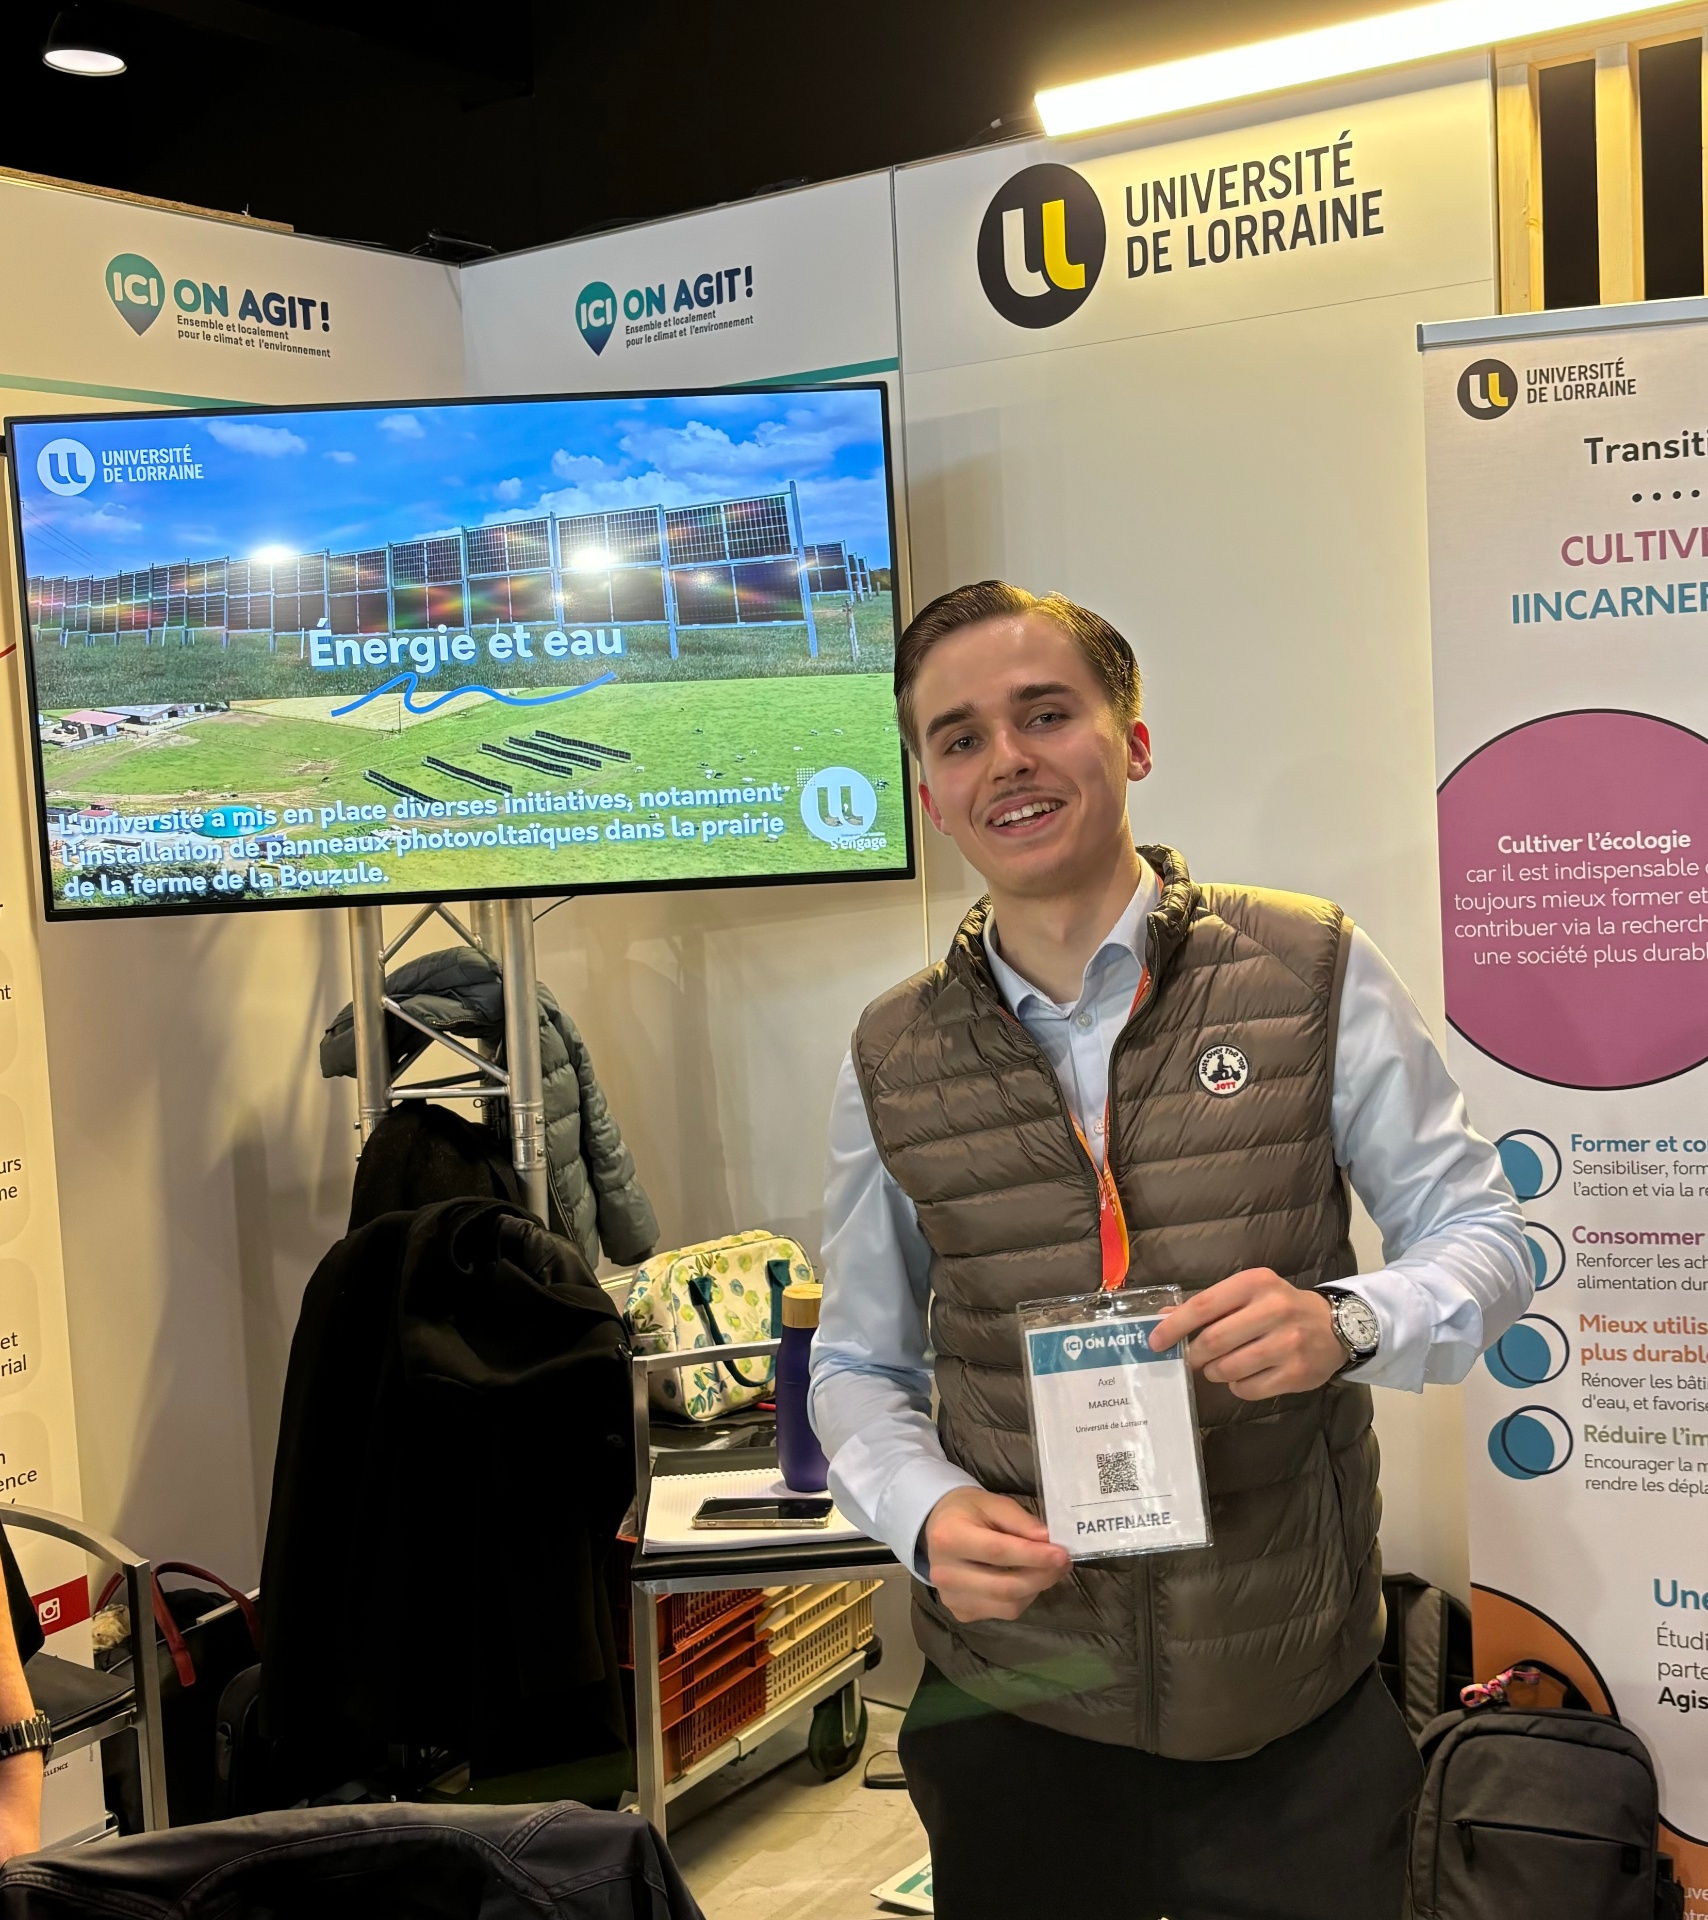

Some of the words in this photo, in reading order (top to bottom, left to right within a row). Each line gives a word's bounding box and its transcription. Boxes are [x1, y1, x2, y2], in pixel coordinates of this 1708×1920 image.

[1125, 129, 1355, 227] UNIVERSITÉ
[1127, 229, 1173, 279] DE
[1187, 189, 1384, 267] LORRAINE
[113, 272, 159, 307] ICI
[173, 278, 229, 317] ON
[580, 298, 613, 330] ICI
[623, 283, 666, 321] ON
[177, 314, 224, 331] Ensemble
[225, 321, 236, 333] et
[238, 323, 289, 340] localement
[625, 319, 662, 335] Ensemble
[663, 318, 672, 328] et
[673, 309, 716, 326] localement
[626, 338, 643, 349] pour
[644, 334, 652, 344] le
[653, 328, 677, 342] climat
[678, 328, 687, 338] et
[690, 315, 754, 335] l'environnement
[178, 328, 200, 341] pour
[202, 330, 211, 342] le
[213, 333, 243, 347] climat
[245, 337, 255, 348] et
[259, 338, 331, 358] l'environnement
[1526, 357, 1625, 386] UNIVERSITÉ
[1527, 387, 1548, 404] DE
[1554, 378, 1637, 402] LORRAINE
[101, 444, 193, 466] UNIVERSITÉ
[103, 467, 124, 483] DE
[128, 463, 204, 482] LORRAINE
[308, 618, 477, 674] Énergie
[488, 624, 534, 660] et
[543, 627, 624, 658] eau
[58, 806, 205, 836] L'université
[211, 811, 226, 828] a
[232, 803, 277, 828] mis
[283, 805, 310, 825] en
[320, 800, 387, 829] place
[393, 795, 498, 819] diverses
[504, 789, 635, 815] initiatives,
[639, 782, 783, 809] notamment
[61, 838, 223, 868] l'installation
[229, 835, 260, 860] de
[267, 836, 390, 867] panneaux
[396, 820, 600, 857] photovoltaïques
[605, 816, 666, 841] dans
[671, 815, 696, 838] la
[701, 812, 785, 843] prairie
[1498, 834, 1583, 854] Cultiver
[1587, 830, 1691, 854] l’écologie
[63, 874, 95, 899] de
[102, 871, 126, 896] la
[133, 869, 207, 894] ferme
[212, 867, 243, 891] de
[249, 866, 274, 888] la
[280, 860, 390, 888] Bouzule.
[1466, 868, 1496, 883] car
[1502, 863, 1514, 882] il
[1519, 863, 1549, 881] est
[1554, 857, 1699, 884] indispensable
[1454, 892, 1537, 915] toujours
[1542, 890, 1606, 908] mieux
[1611, 887, 1684, 906] former
[1454, 918, 1557, 938] contribuer
[1562, 918, 1591, 936] via
[1597, 916, 1616, 935] la
[1474, 951, 1511, 965] une
[1517, 944, 1588, 965] société
[1594, 943, 1638, 968] plus
[1214, 1081, 1236, 1091] JOTT
[1571, 1133, 1651, 1153] Former
[1656, 1136, 1679, 1153] et
[1572, 1160, 1669, 1178] Sensibiliser,
[1573, 1181, 1628, 1197] l’action
[1632, 1183, 1649, 1197] et
[1651, 1183, 1675, 1197] via
[1679, 1181, 1694, 1197] la
[1572, 1225, 1706, 1246] Consommer
[1576, 1252, 1654, 1268] Renforcer
[1657, 1254, 1680, 1269] les
[1577, 1274, 1677, 1290] alimentation
[1579, 1313, 1648, 1334] Mieux
[0, 1332, 19, 1350] et
[1066, 1341, 1081, 1352] ICI
[1085, 1336, 1105, 1350] ON
[1, 1354, 27, 1377] rial
[1580, 1342, 1628, 1366] plus
[1098, 1376, 1116, 1387] Axel
[1581, 1372, 1646, 1388] Rénover
[1650, 1374, 1673, 1389] les
[1088, 1397, 1130, 1409] MARCHAL
[1581, 1393, 1630, 1412] d'eau,
[1633, 1396, 1650, 1410] et
[1075, 1422, 1109, 1433] Université
[1110, 1421, 1120, 1429] de
[1583, 1424, 1667, 1445] Réduire
[1584, 1453, 1675, 1475] Encourager
[1678, 1456, 1692, 1472] la
[1585, 1476, 1638, 1491] rendre
[1642, 1477, 1665, 1492] les
[1076, 1511, 1172, 1535] PARTENAIRE
[1657, 1686, 1708, 1713] Agis
